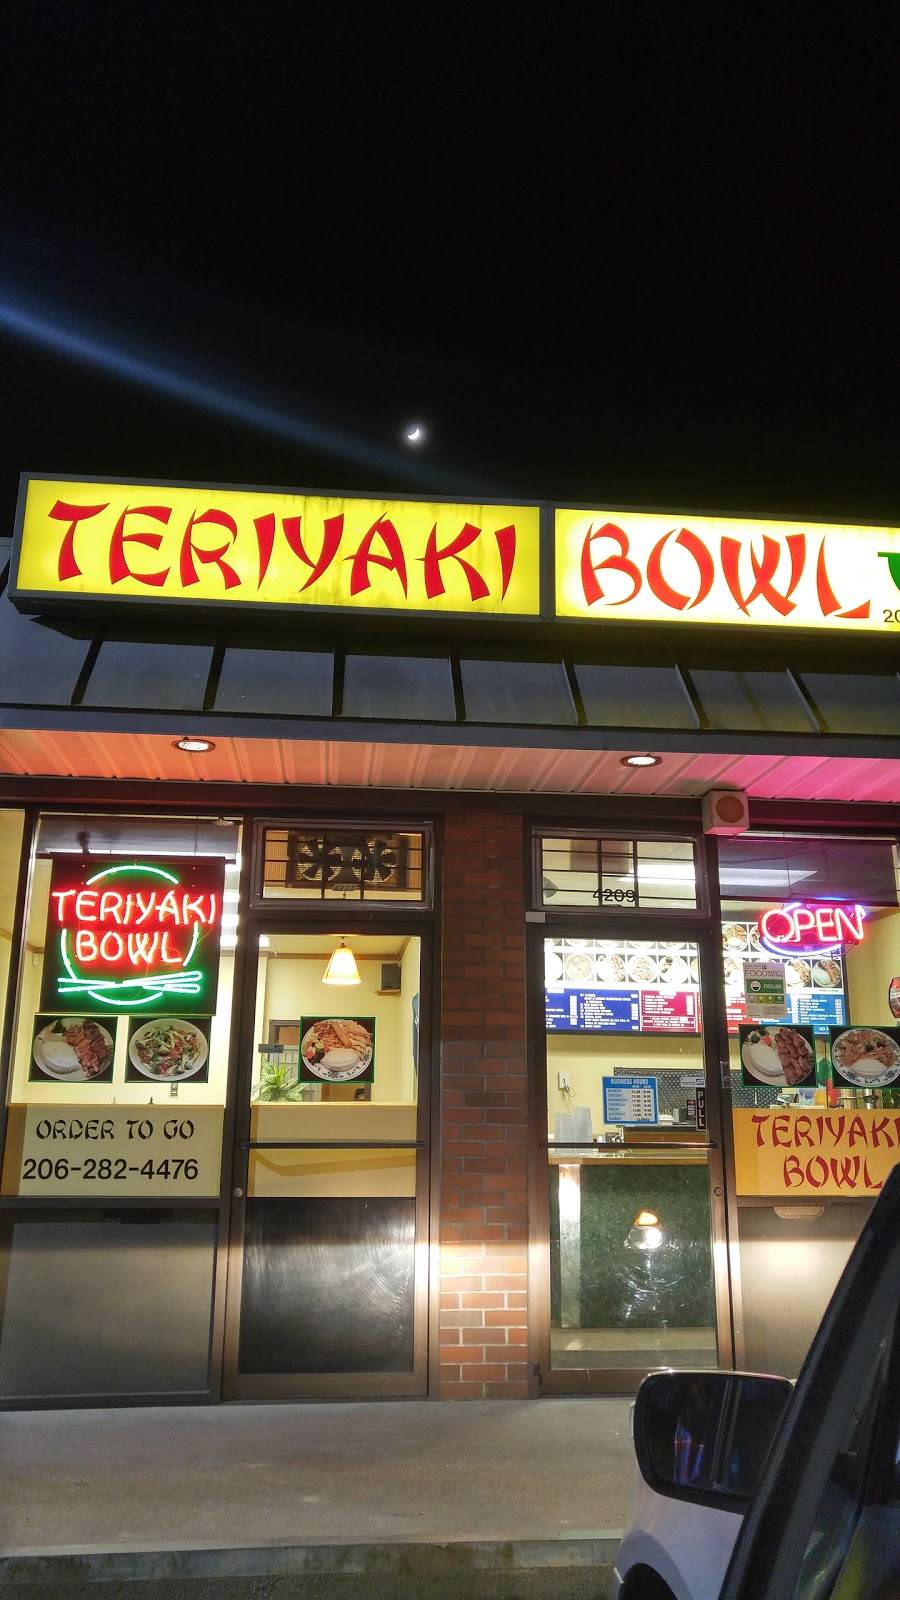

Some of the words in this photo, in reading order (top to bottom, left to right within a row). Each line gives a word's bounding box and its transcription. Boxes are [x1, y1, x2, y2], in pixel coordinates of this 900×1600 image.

[48, 499, 517, 602] TERIYAKI
[580, 521, 871, 619] BOWL
[51, 889, 216, 925] TERIYAKI
[592, 888, 636, 903] 4209
[761, 905, 866, 943] OPEN
[75, 929, 183, 965] BOWL
[697, 1090, 705, 1127] PULL
[36, 1119, 115, 1140] ORDER
[126, 1119, 154, 1140] TO
[163, 1119, 195, 1140] GO
[22, 1158, 199, 1180] 206-282-4476
[783, 1154, 883, 1189] BOWL
